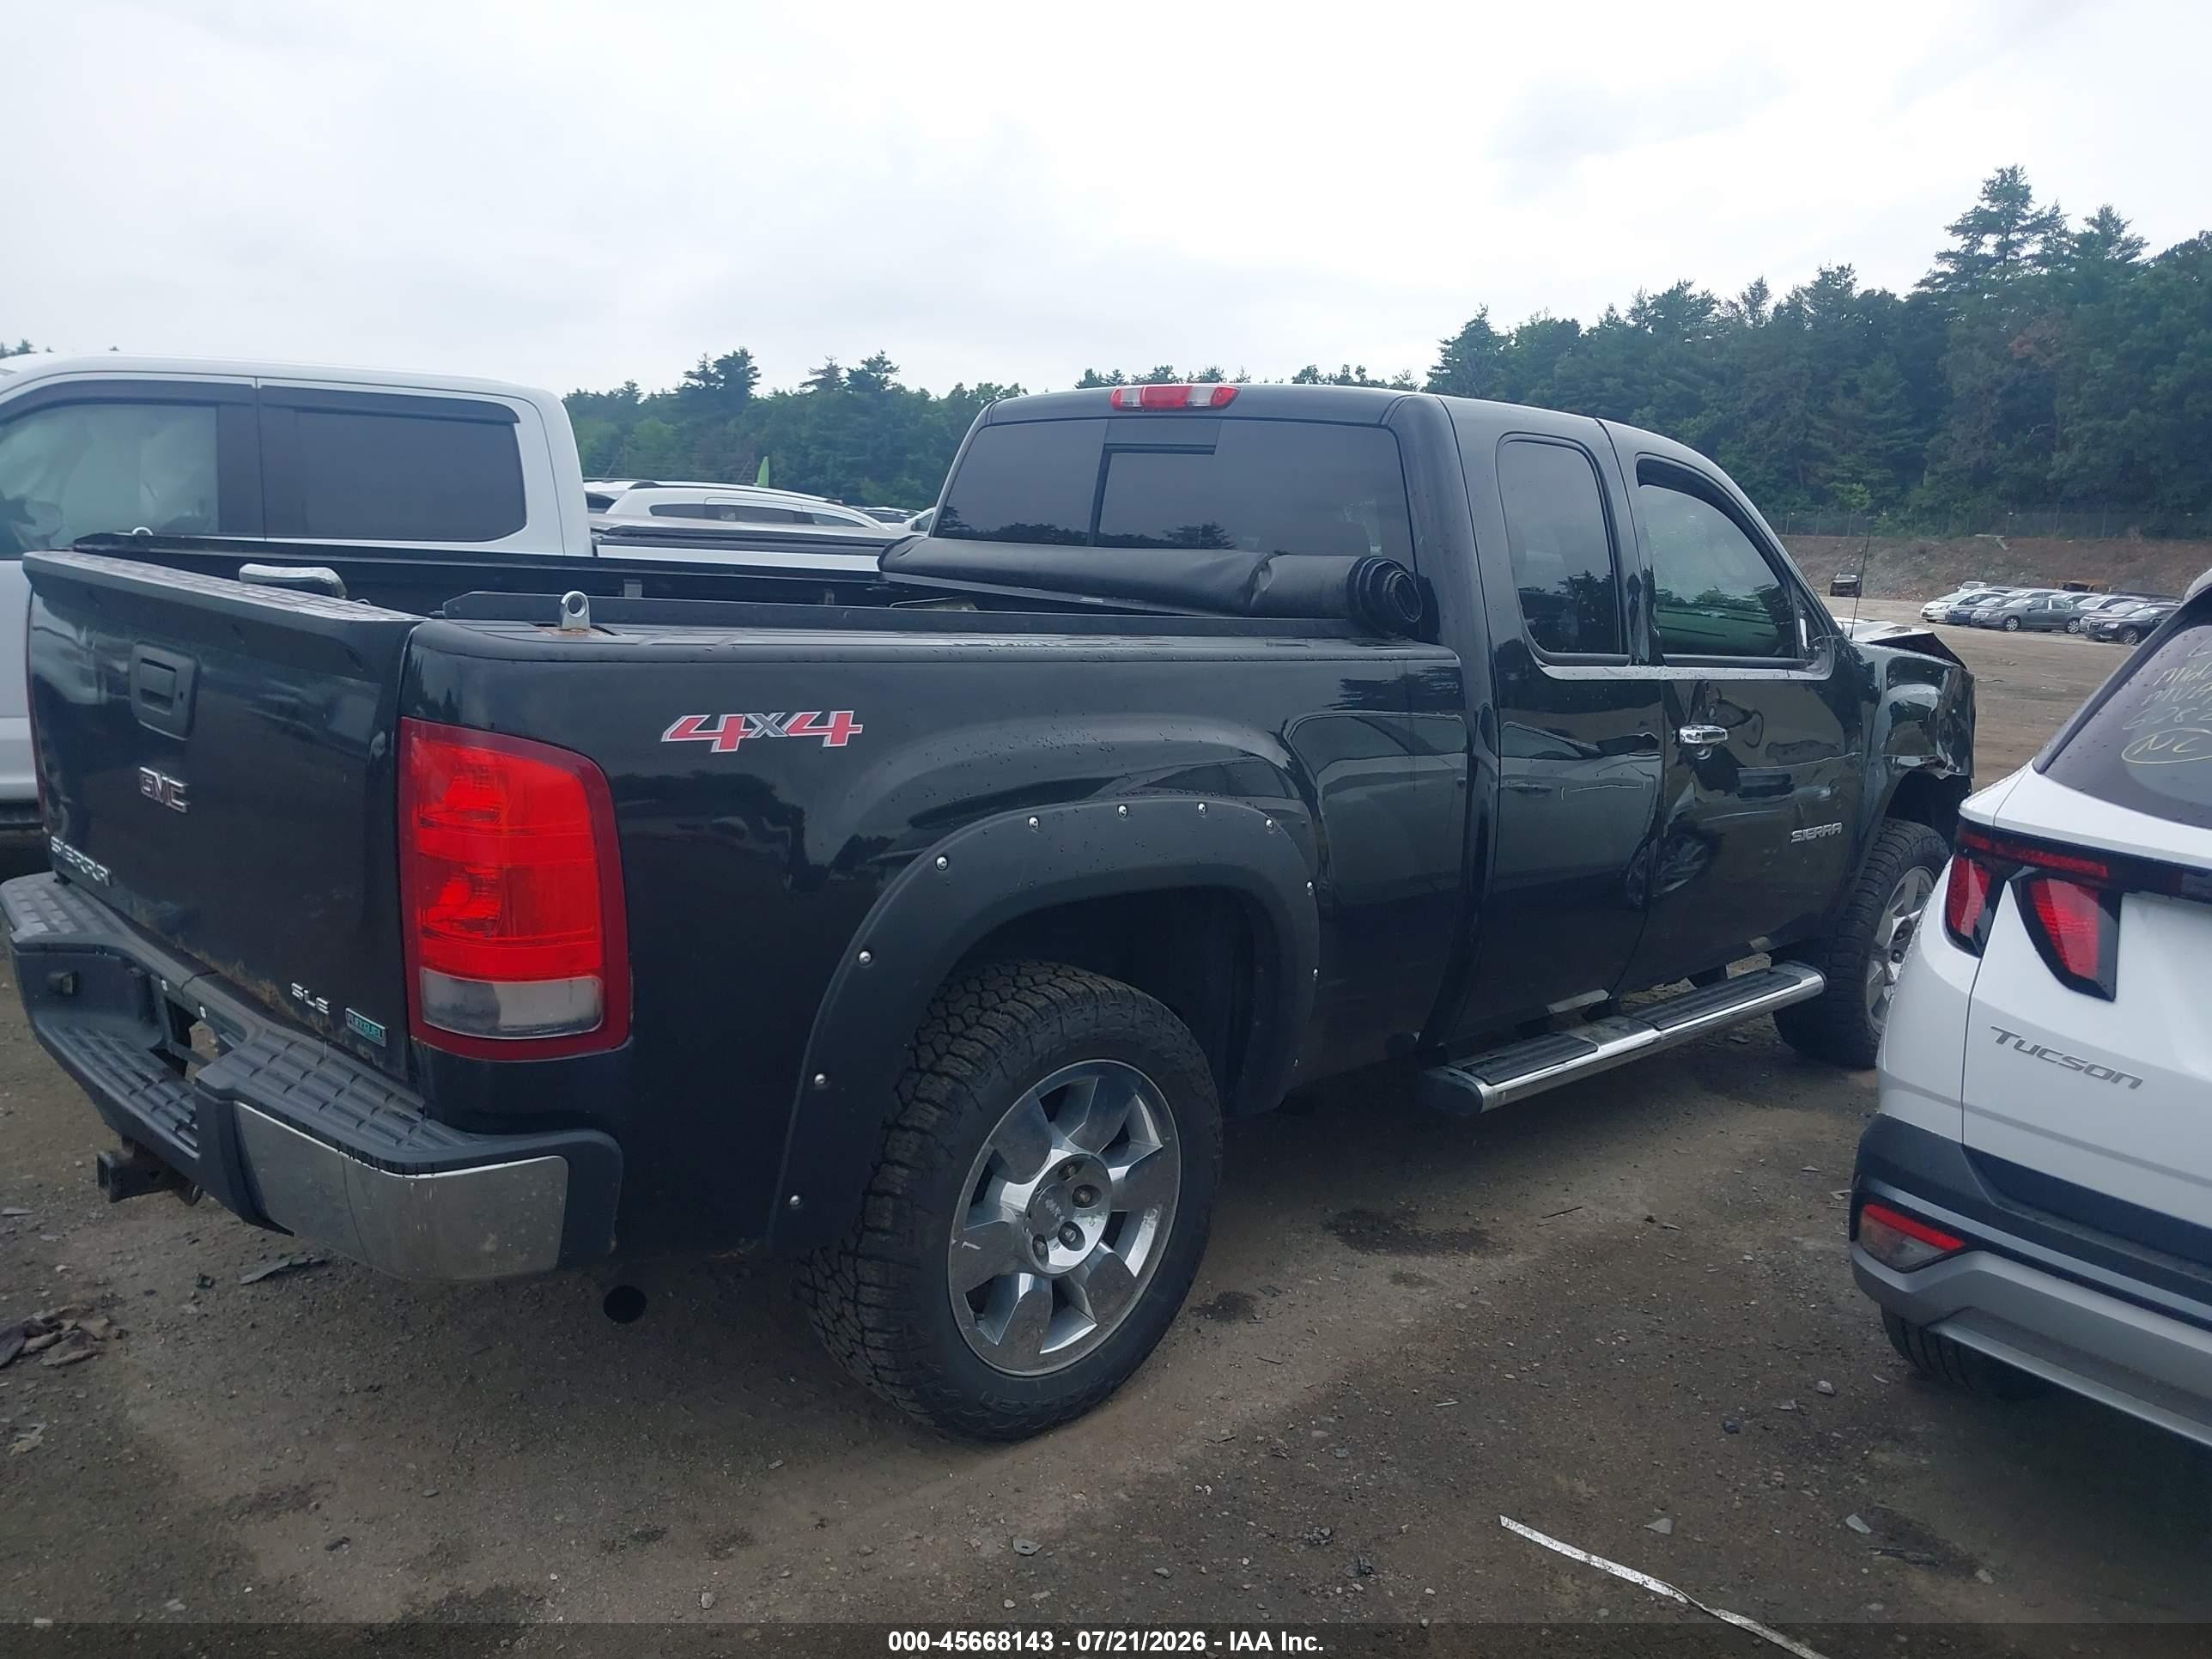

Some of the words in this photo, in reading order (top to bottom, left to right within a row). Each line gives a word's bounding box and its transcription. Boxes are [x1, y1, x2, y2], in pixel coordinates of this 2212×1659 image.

[139, 765, 191, 813] GMC
[1790, 822, 1843, 843] SIERRA
[50, 836, 112, 887] SIERRA
[291, 981, 329, 1014] SLE
